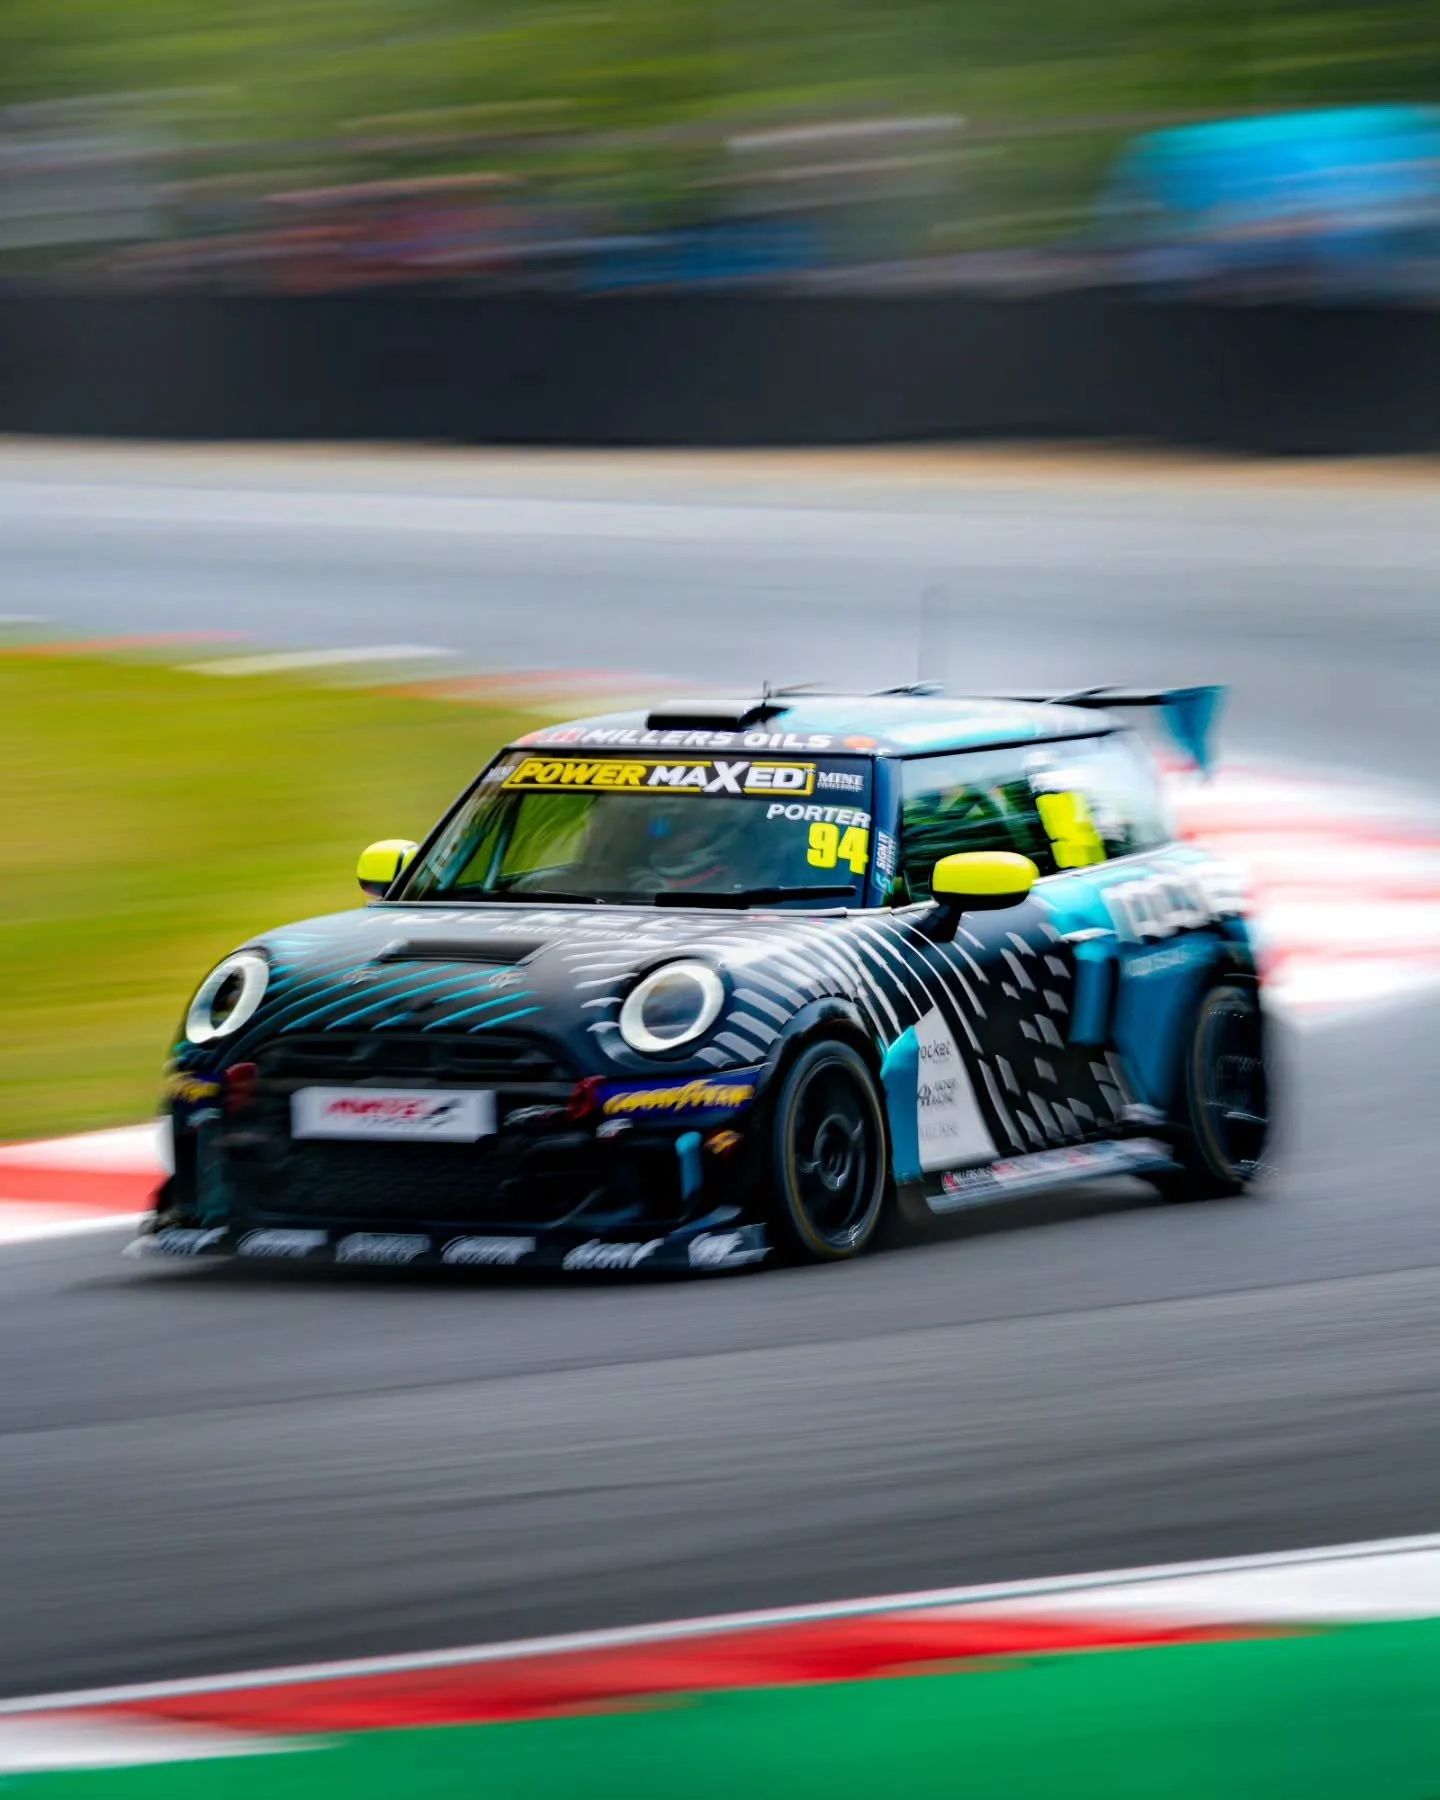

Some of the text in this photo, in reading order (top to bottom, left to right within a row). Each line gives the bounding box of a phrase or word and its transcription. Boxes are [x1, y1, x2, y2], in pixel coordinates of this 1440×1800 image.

[580, 729, 834, 749] MILLERS OILS
[511, 762, 648, 786] POWER
[647, 761, 807, 793] MAXED
[766, 803, 871, 829] PORTER
[806, 822, 869, 875] 94
[915, 1040, 951, 1060] ocket
